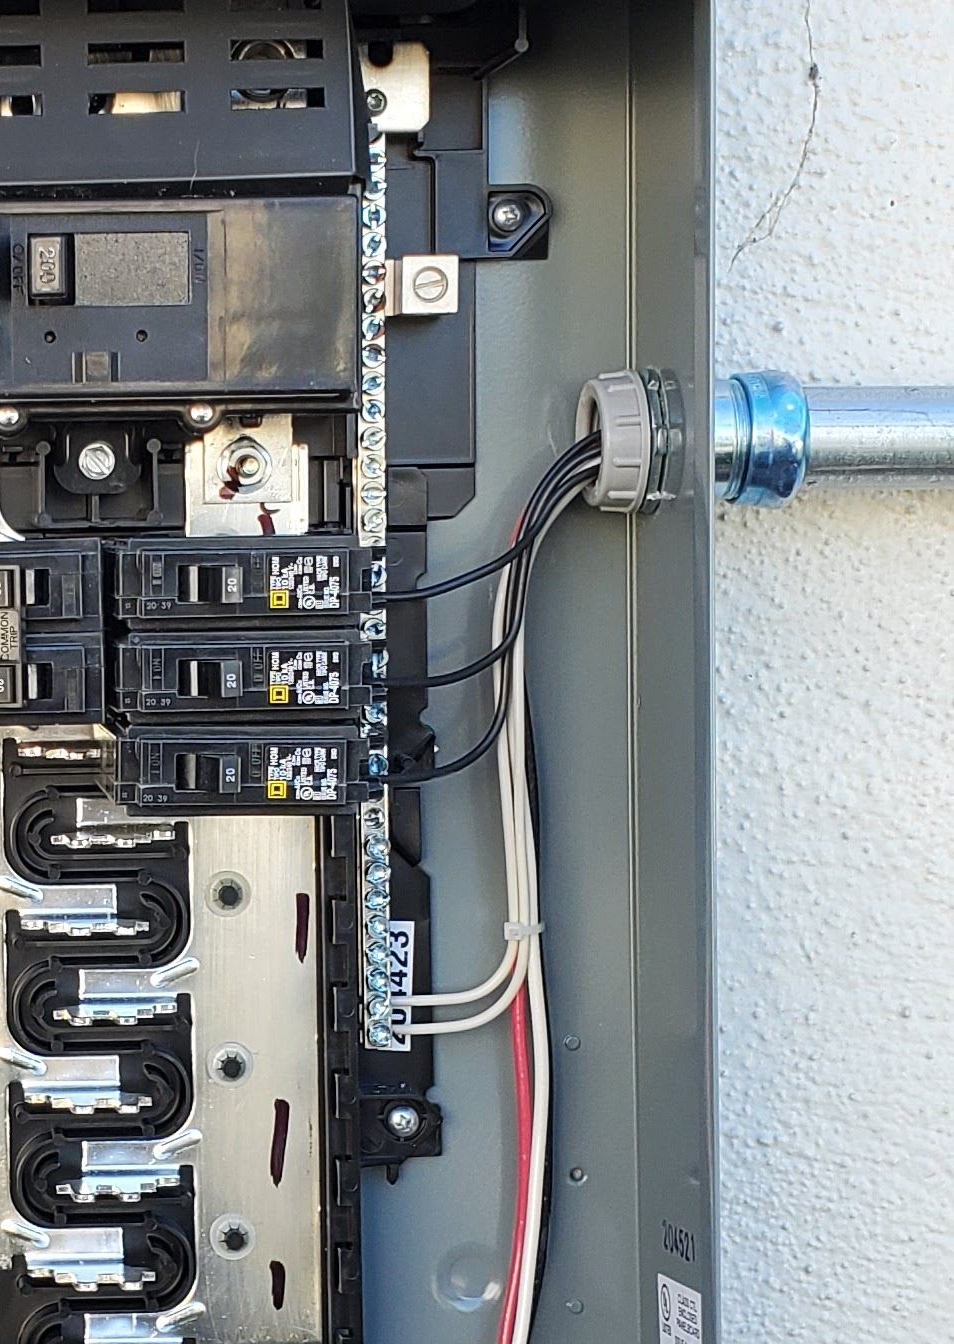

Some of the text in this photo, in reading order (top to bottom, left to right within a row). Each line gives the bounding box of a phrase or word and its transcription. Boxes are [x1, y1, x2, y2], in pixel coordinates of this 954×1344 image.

[38, 246, 56, 284] 200
[228, 578, 237, 592] 20
[227, 674, 236, 688] 20
[226, 768, 236, 782] 20
[662, 1219, 696, 1262] 204521
